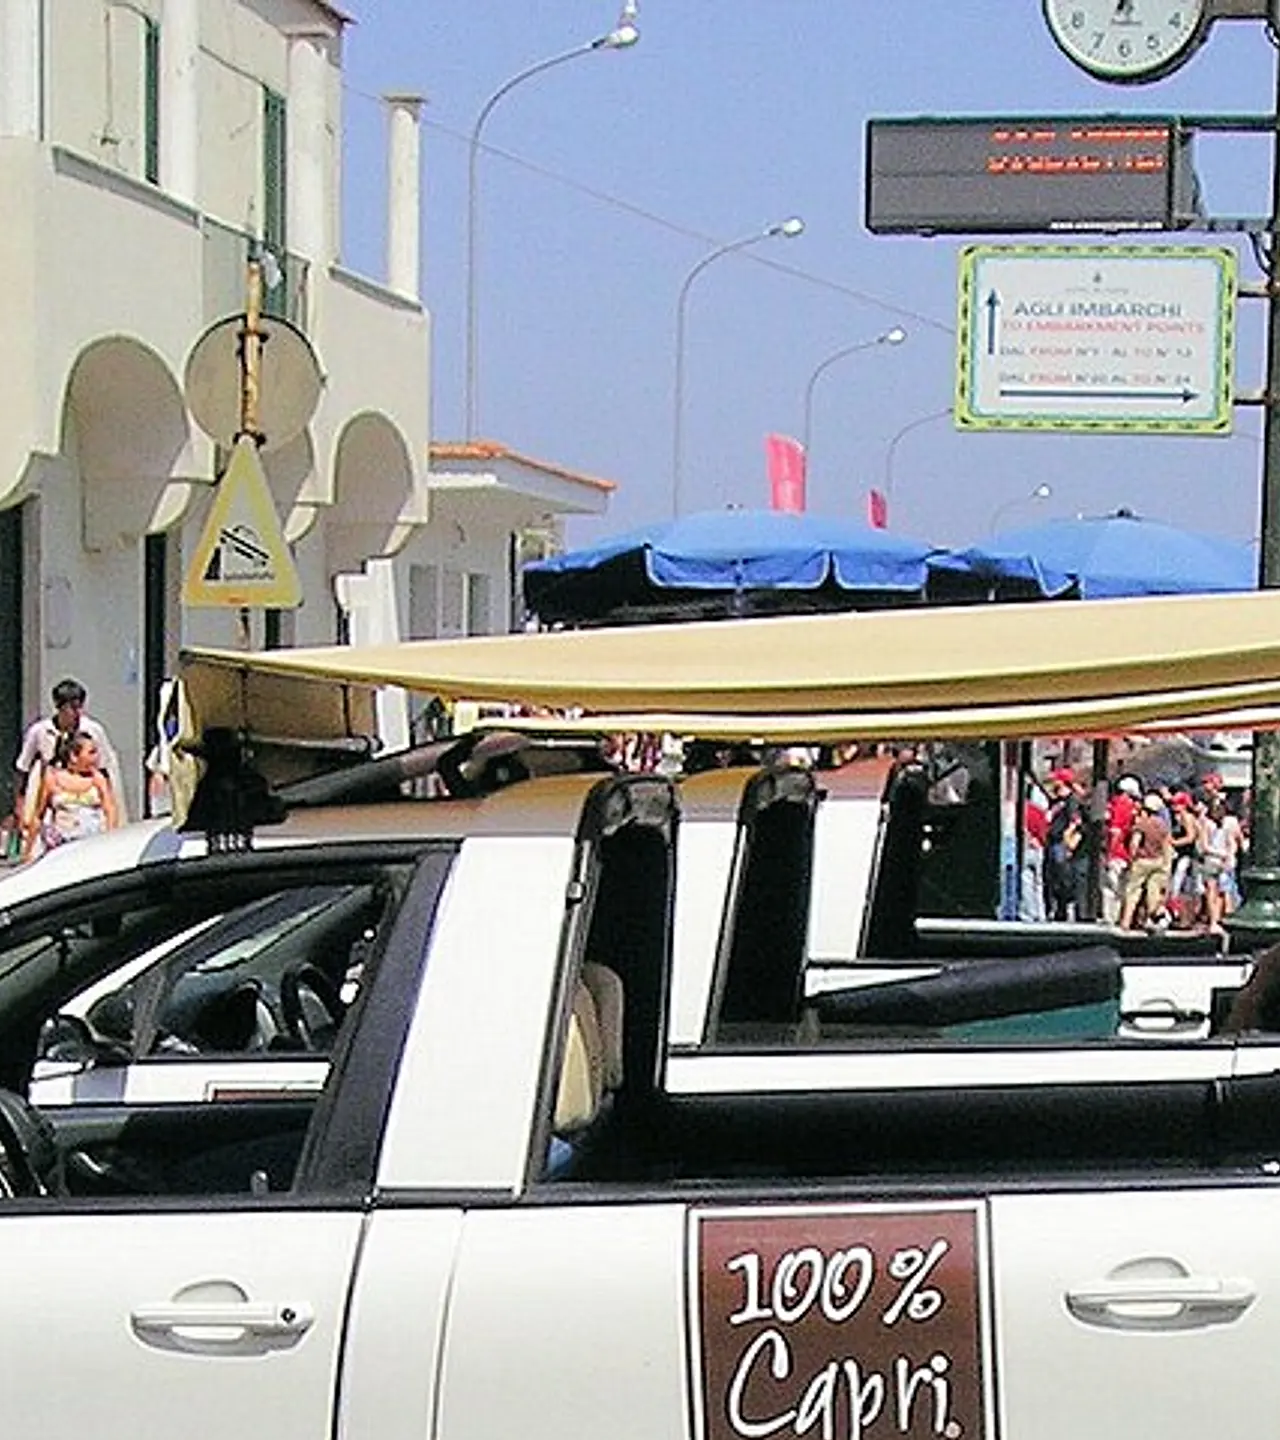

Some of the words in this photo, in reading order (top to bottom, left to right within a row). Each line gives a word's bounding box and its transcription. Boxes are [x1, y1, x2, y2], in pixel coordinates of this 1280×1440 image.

[1013, 302, 1065, 317] AGLI
[1070, 302, 1182, 318] IMBARCHI
[727, 1247, 873, 1324] 100
[883, 1238, 948, 1325] %
